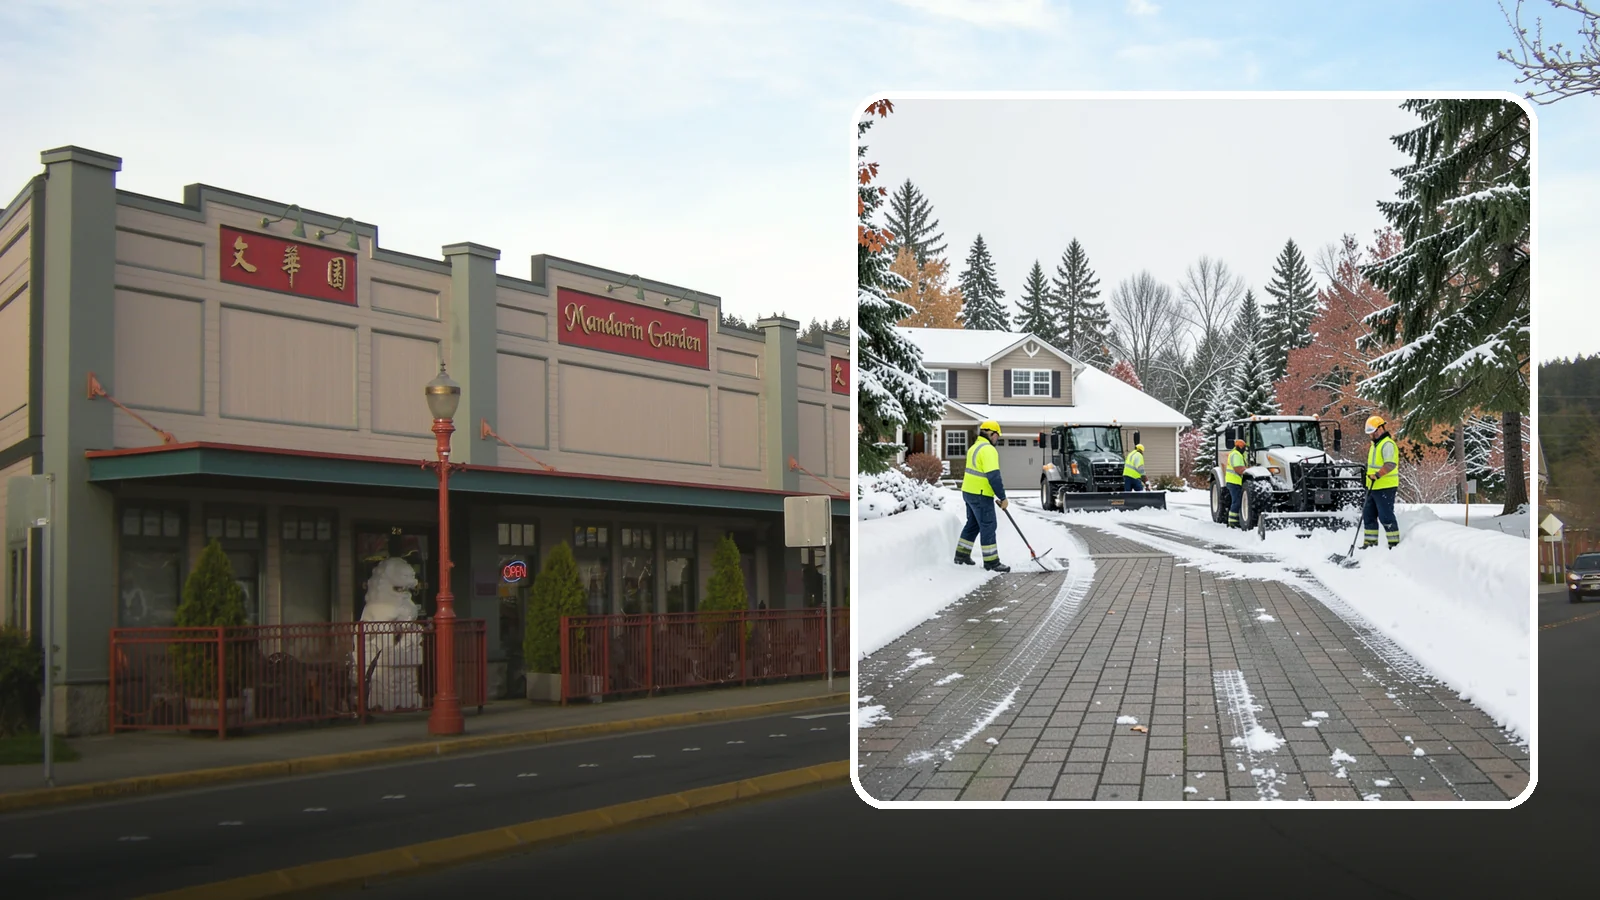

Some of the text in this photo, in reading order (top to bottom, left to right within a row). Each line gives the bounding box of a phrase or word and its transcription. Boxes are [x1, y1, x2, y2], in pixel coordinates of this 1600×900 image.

[231, 236, 346, 290] 文華園
[564, 302, 701, 352] Mandarin Garden
[503, 565, 526, 578] OPEN
